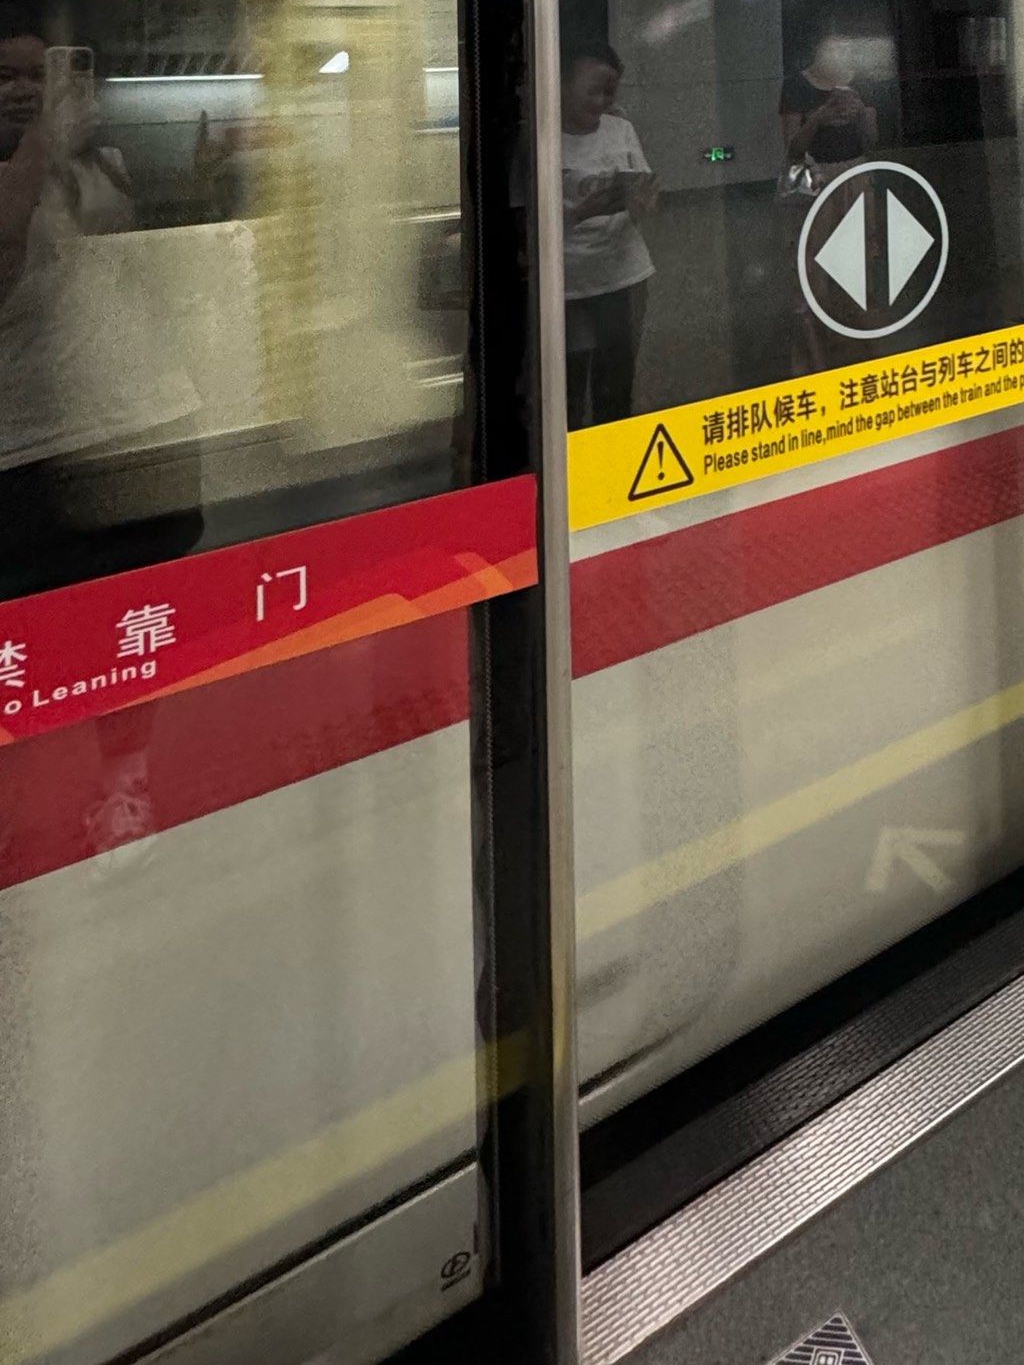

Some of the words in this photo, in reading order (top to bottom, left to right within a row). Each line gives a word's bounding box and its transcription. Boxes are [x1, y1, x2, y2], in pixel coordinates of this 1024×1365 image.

[704, 450, 748, 475] Please
[751, 435, 785, 462] stand
[788, 434, 799, 452] in
[856, 413, 873, 432] the
[876, 408, 895, 430] gap
[897, 396, 941, 420] between
[943, 390, 958, 408] the
[960, 383, 982, 403] train
[984, 376, 1001, 396] and
[1003, 373, 1017, 391] the
[33, 659, 157, 707] Leaning
